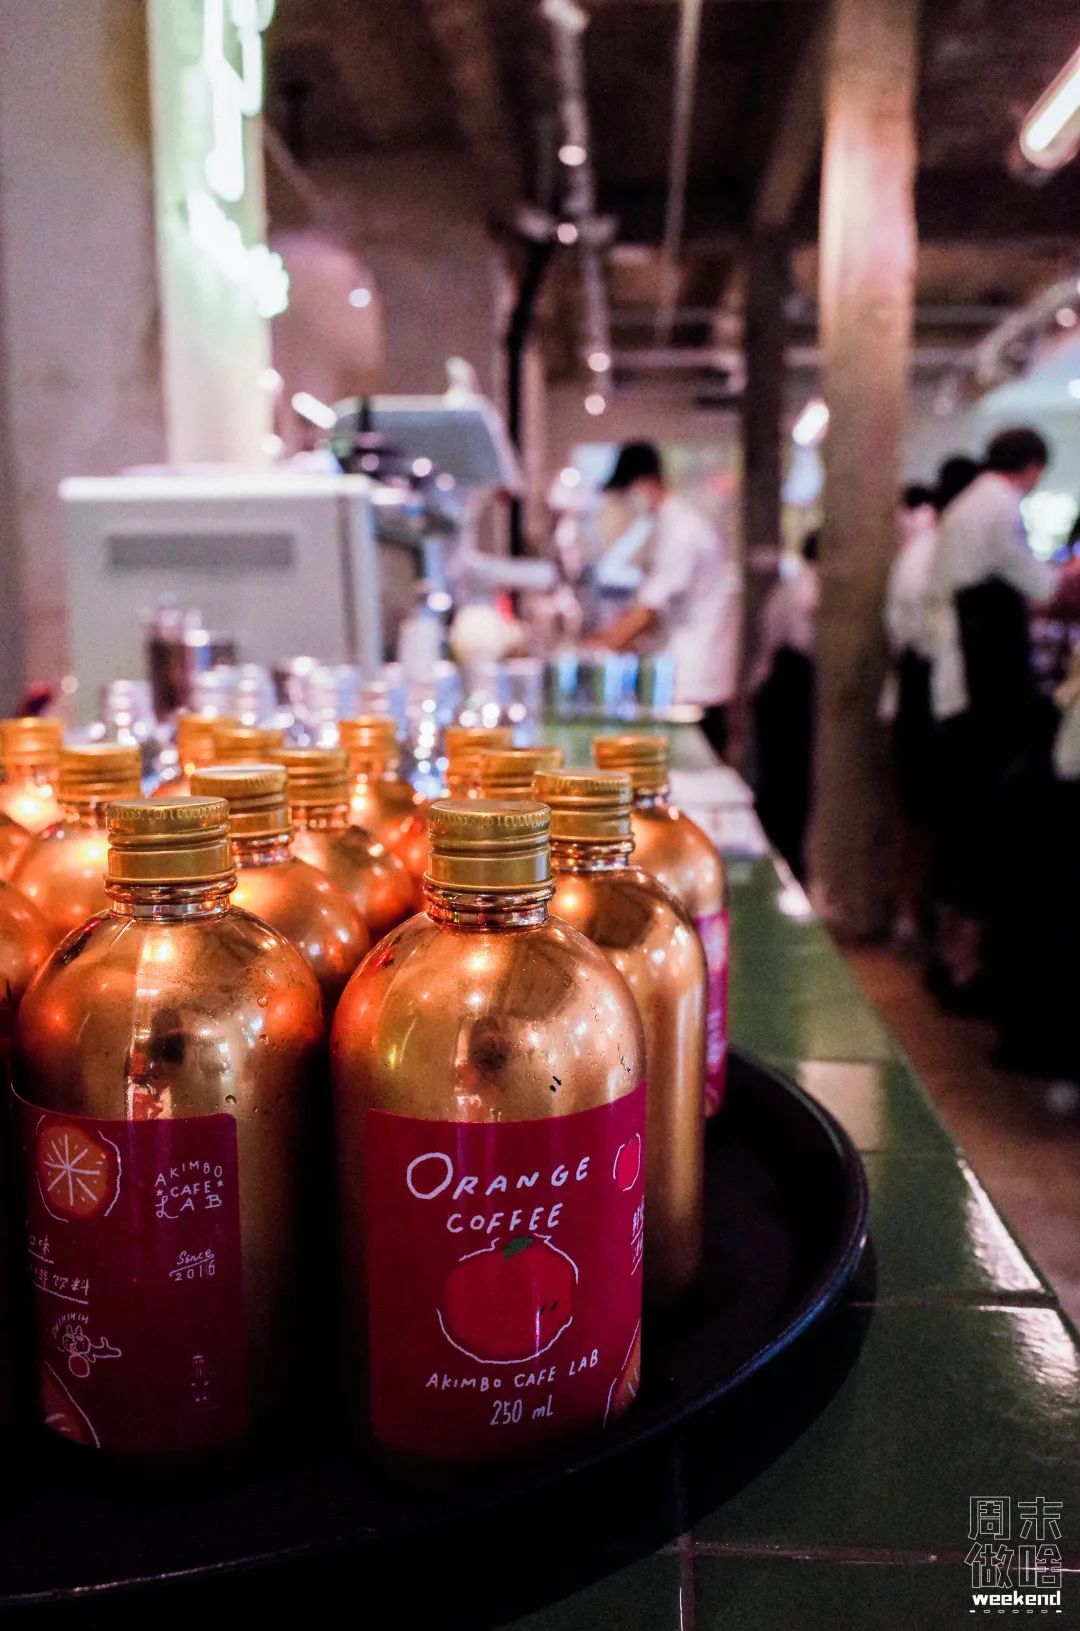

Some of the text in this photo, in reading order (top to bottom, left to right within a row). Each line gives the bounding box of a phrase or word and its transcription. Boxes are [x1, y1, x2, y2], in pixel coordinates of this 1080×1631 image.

[154, 1160, 223, 1188] AKIMBO
[407, 1153, 590, 1199] ORANGE
[170, 1180, 212, 1198] CAFE
[154, 1194, 223, 1219] LAB
[446, 1202, 564, 1235] COFFEE
[174, 1259, 216, 1282] 2016
[177, 1248, 216, 1266] Since
[425, 1348, 599, 1392] AKIMBO CAFE LAB
[489, 1399, 523, 1426] 250
